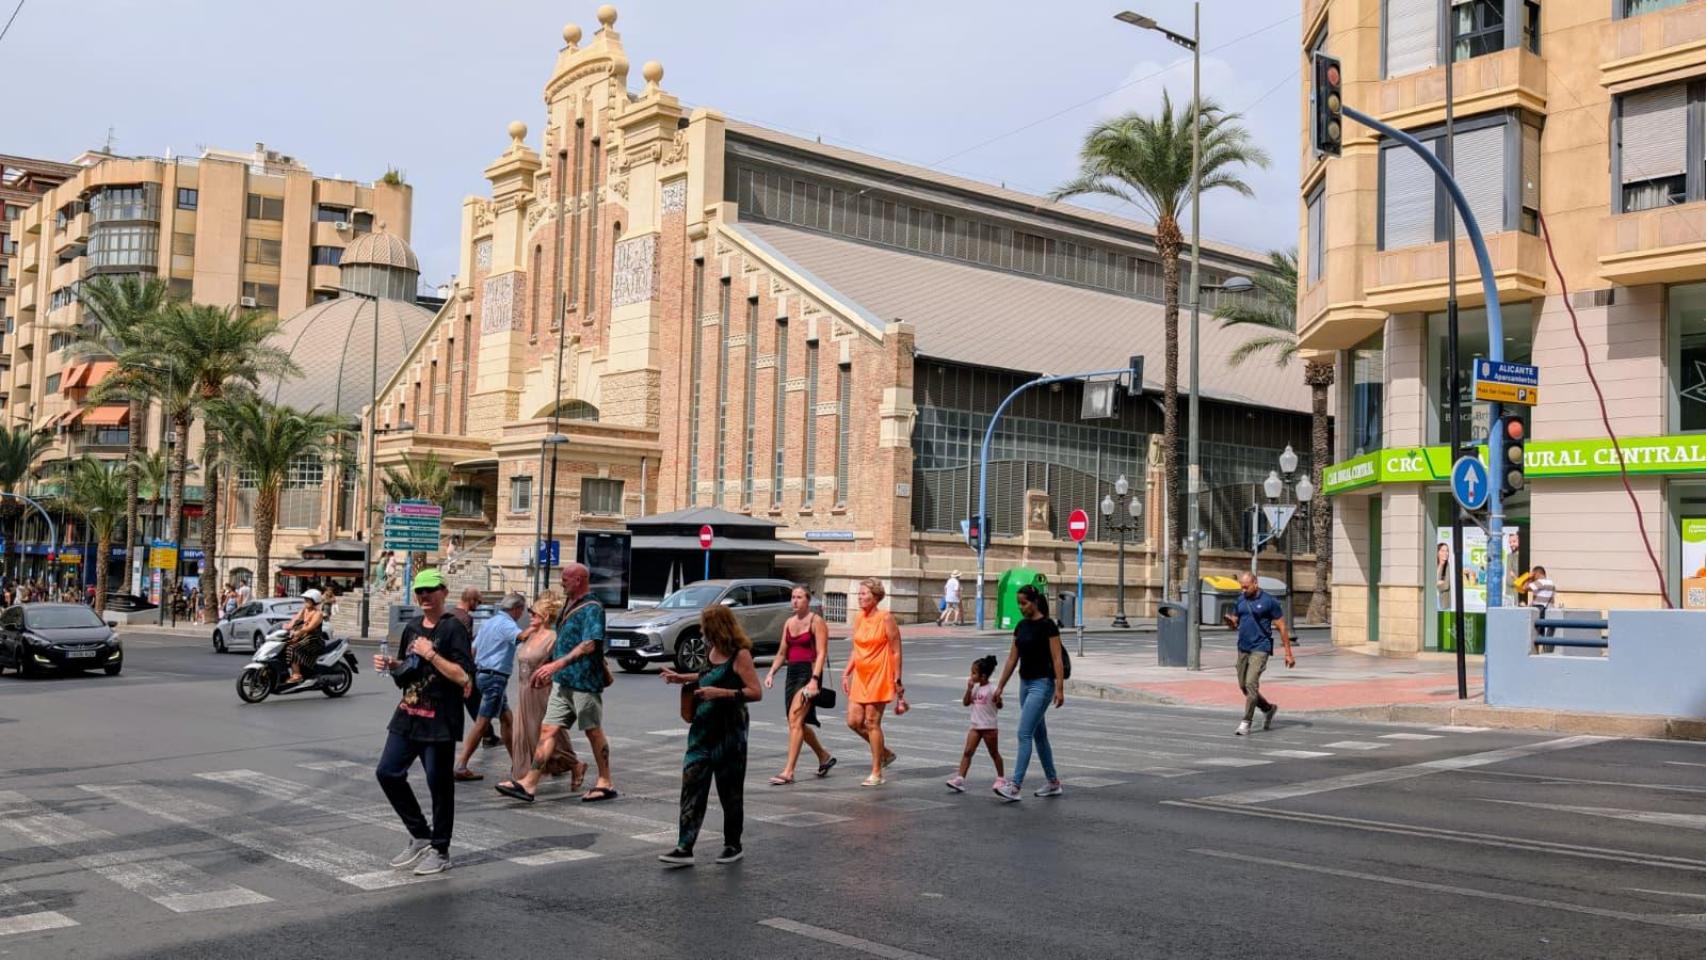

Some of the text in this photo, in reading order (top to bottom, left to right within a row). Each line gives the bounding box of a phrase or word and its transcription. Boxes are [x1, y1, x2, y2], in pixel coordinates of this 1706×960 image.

[1499, 364, 1534, 375] ALICANTE
[1594, 445, 1706, 465] CENTRAL
[1387, 457, 1423, 473] CRC
